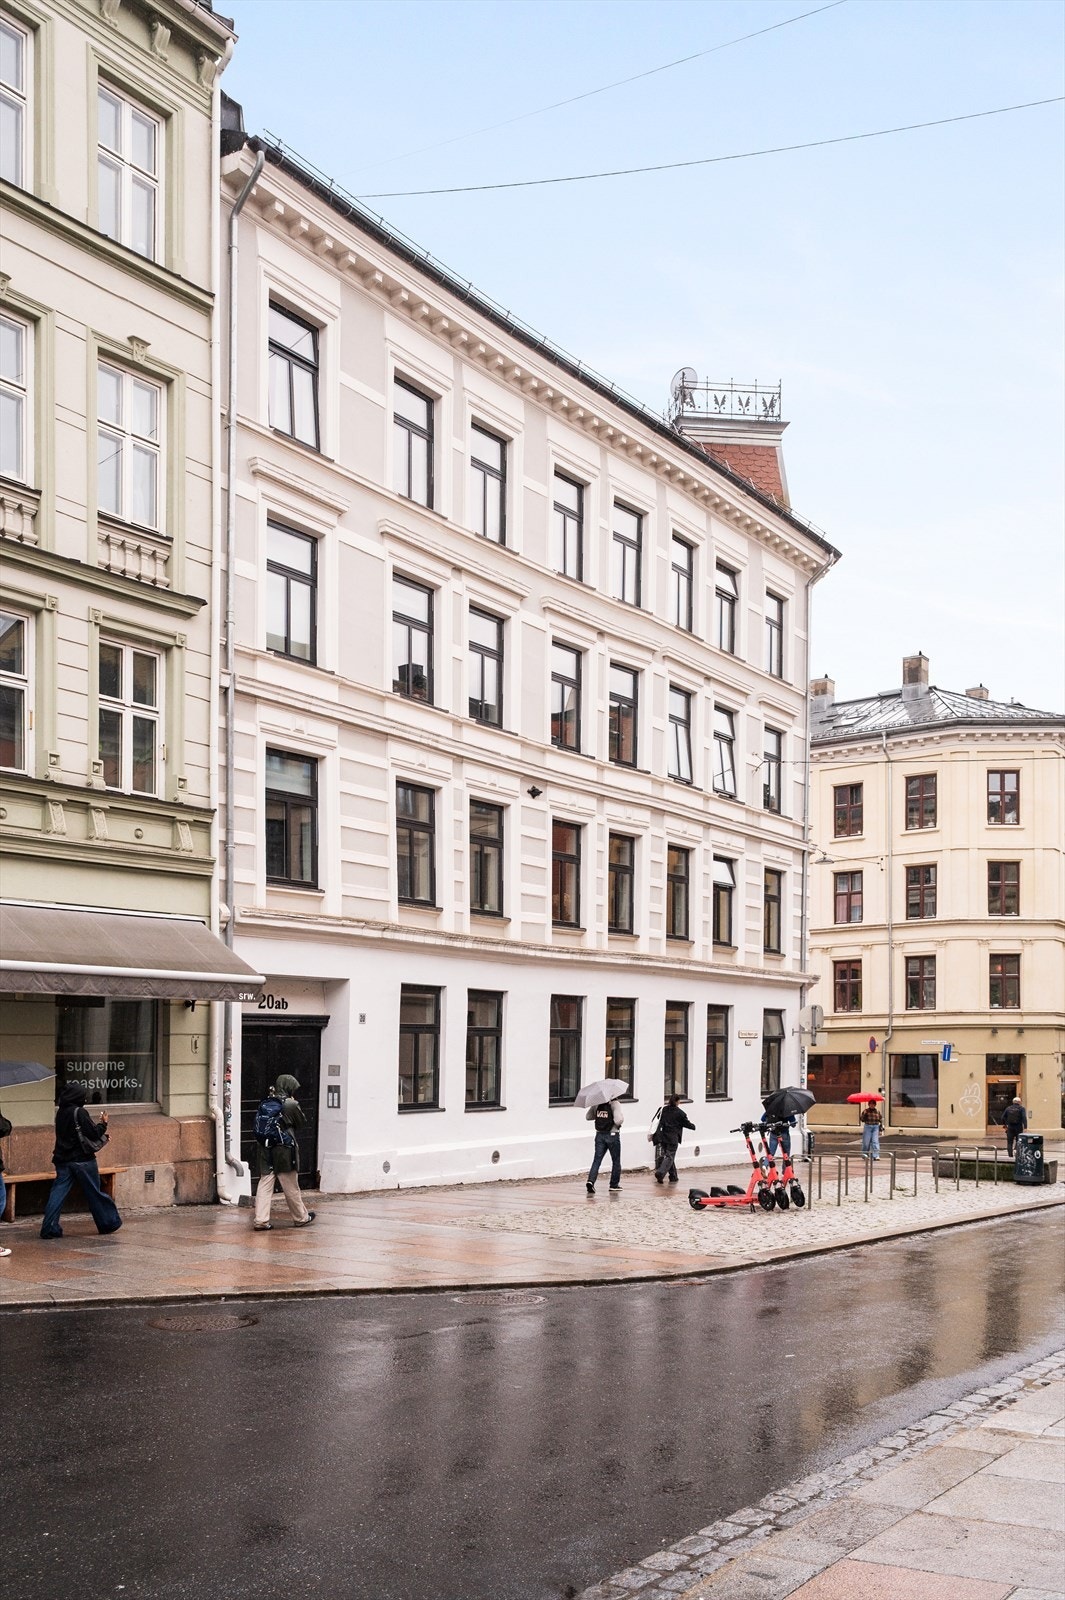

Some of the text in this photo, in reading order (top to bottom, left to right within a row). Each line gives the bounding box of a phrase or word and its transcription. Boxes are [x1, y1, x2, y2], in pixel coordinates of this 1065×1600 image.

[238, 992, 257, 1001] srw.
[258, 993, 289, 1010] 20ab
[66, 1060, 126, 1074] supreme
